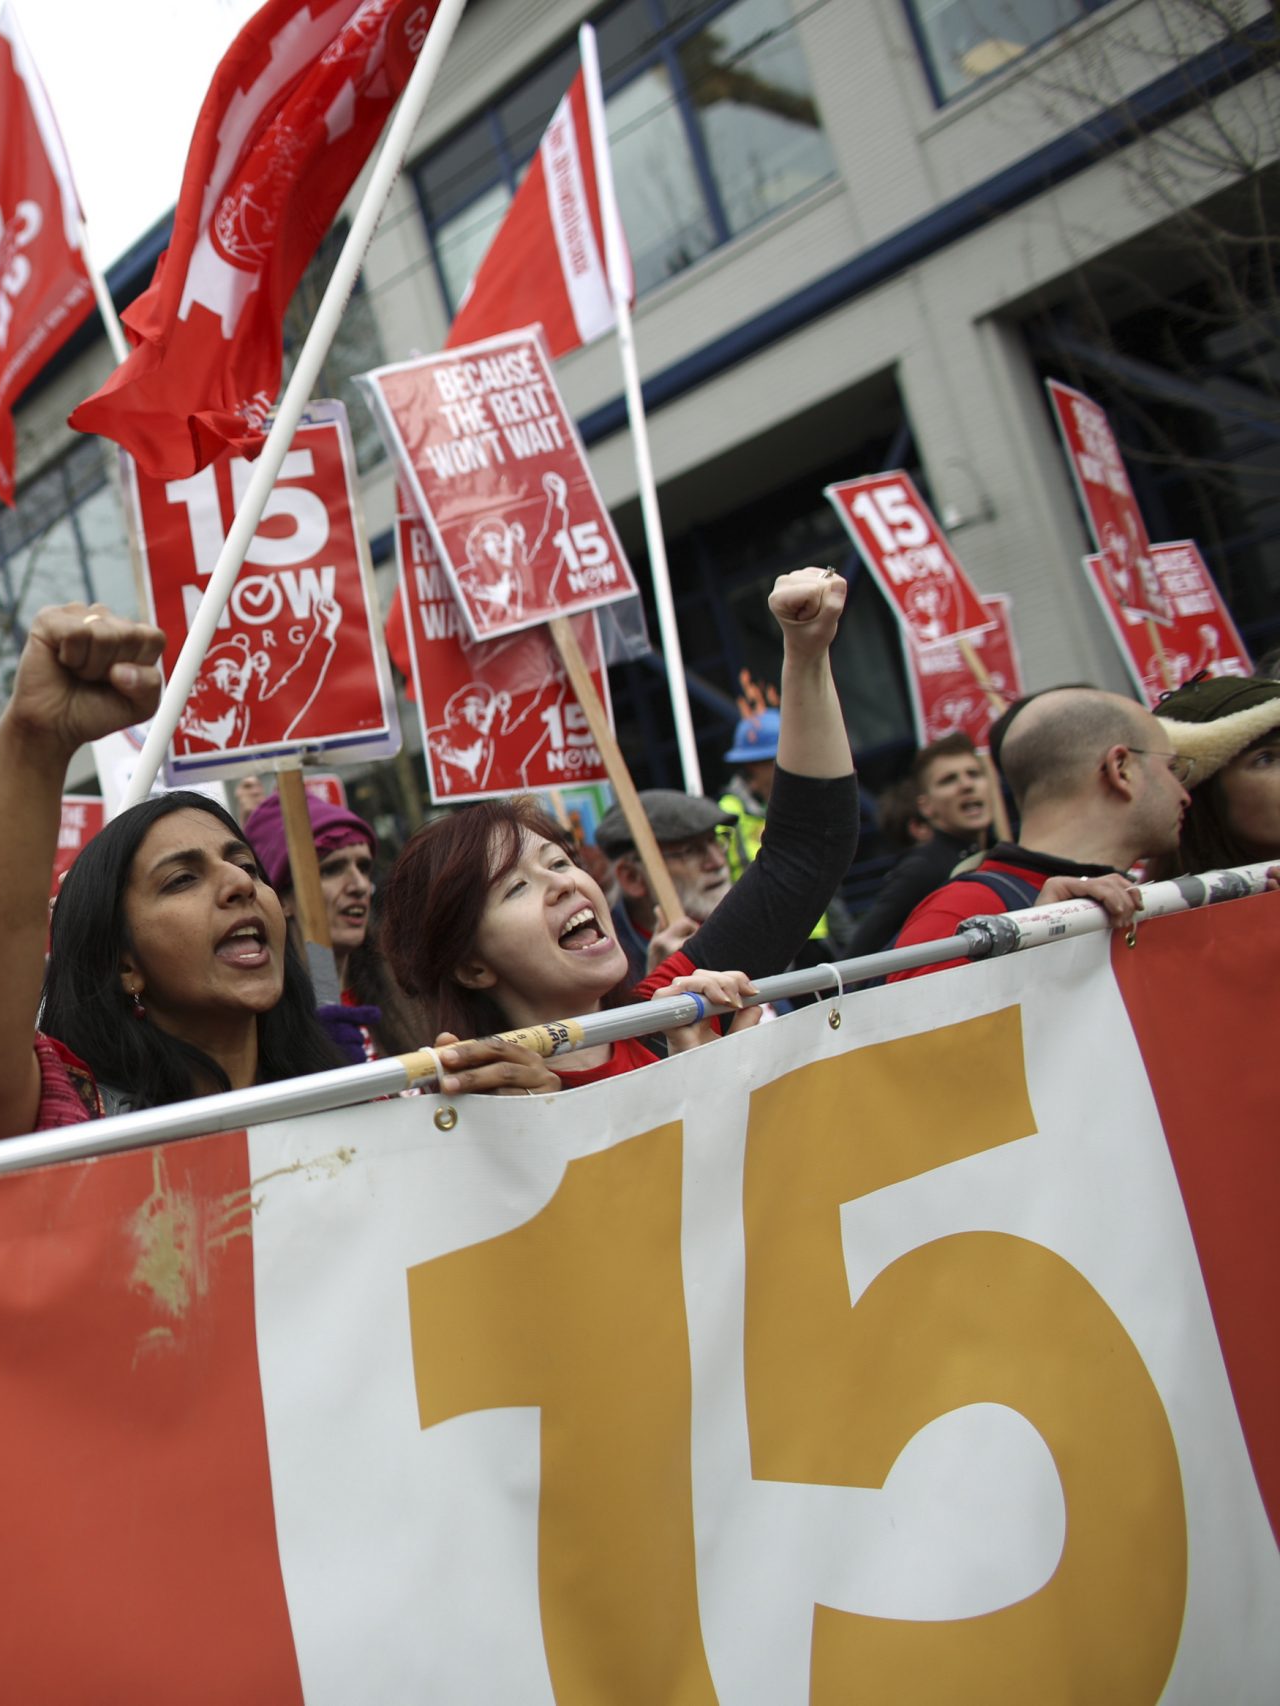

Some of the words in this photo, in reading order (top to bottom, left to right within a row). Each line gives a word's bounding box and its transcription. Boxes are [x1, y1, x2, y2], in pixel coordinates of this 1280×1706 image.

[433, 349, 541, 401] BECAUSE
[438, 396, 493, 438] THE
[489, 382, 551, 427] RENT
[426, 431, 506, 480] WON'T
[503, 415, 565, 460] WAIT
[165, 448, 329, 575] 15
[851, 485, 930, 554] 15
[553, 520, 610, 572] 15
[881, 543, 948, 585] NOW
[567, 561, 618, 594] NOW
[541, 703, 596, 750] 15
[406, 1003, 1189, 1706] 15
